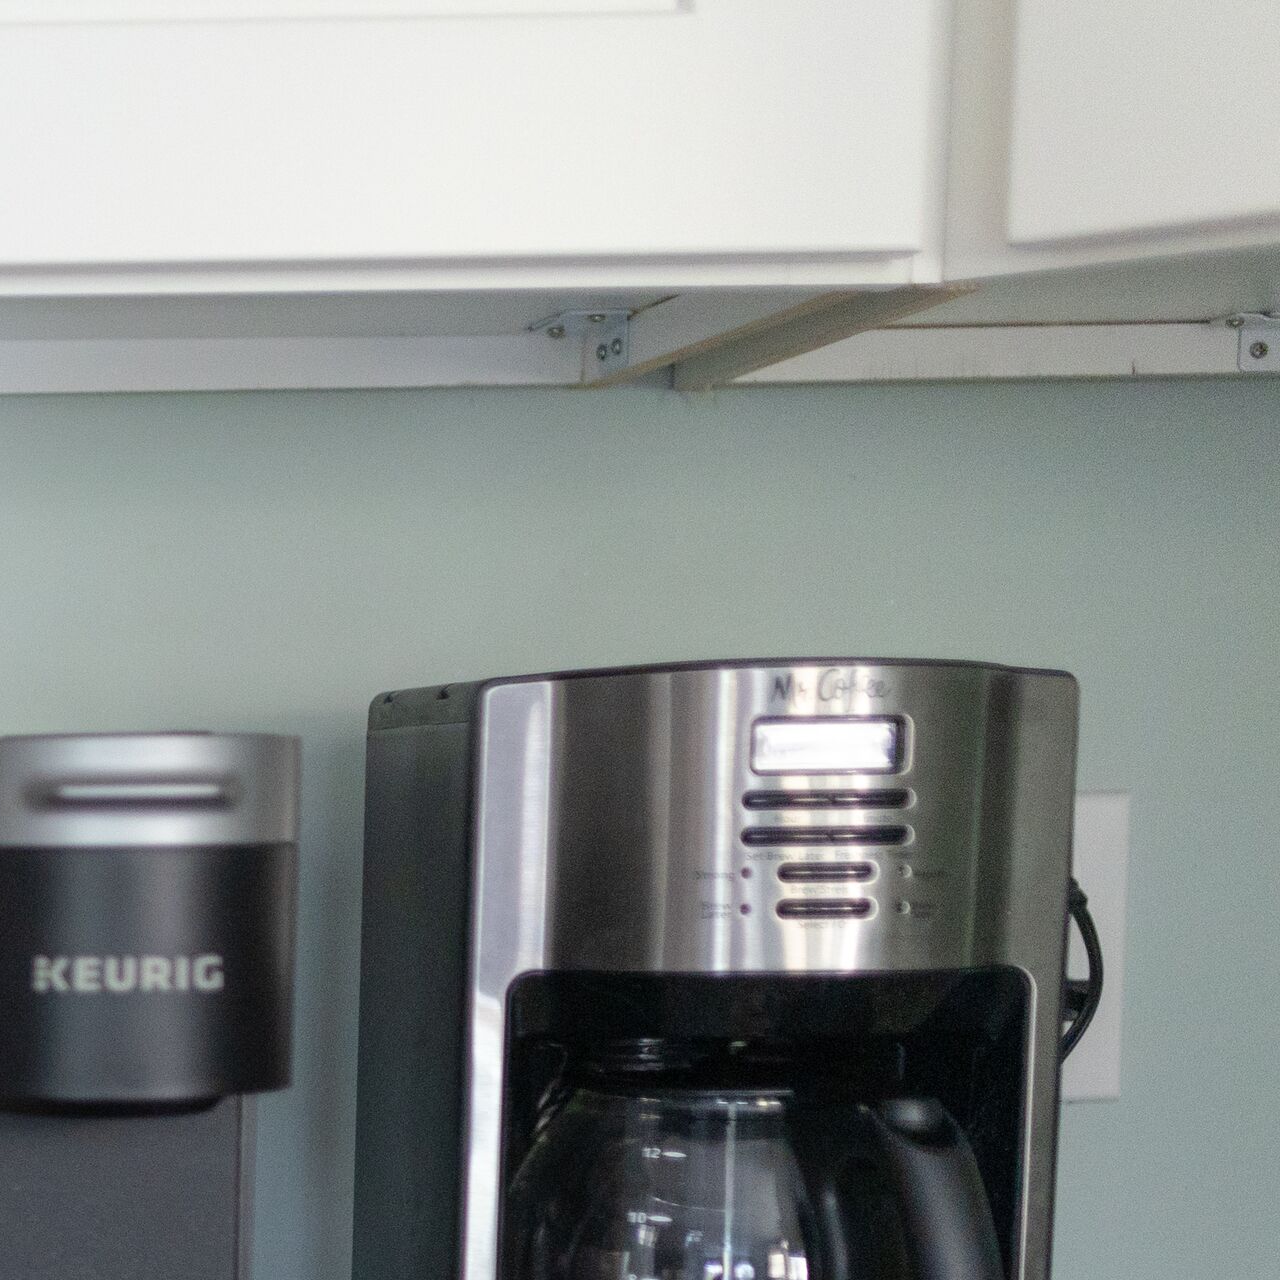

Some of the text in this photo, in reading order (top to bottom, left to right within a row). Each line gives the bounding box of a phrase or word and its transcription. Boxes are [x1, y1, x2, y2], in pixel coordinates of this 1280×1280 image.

[33, 955, 224, 993] KEURIG
[641, 1147, 662, 1159] 12
[627, 1211, 647, 1224] 10
